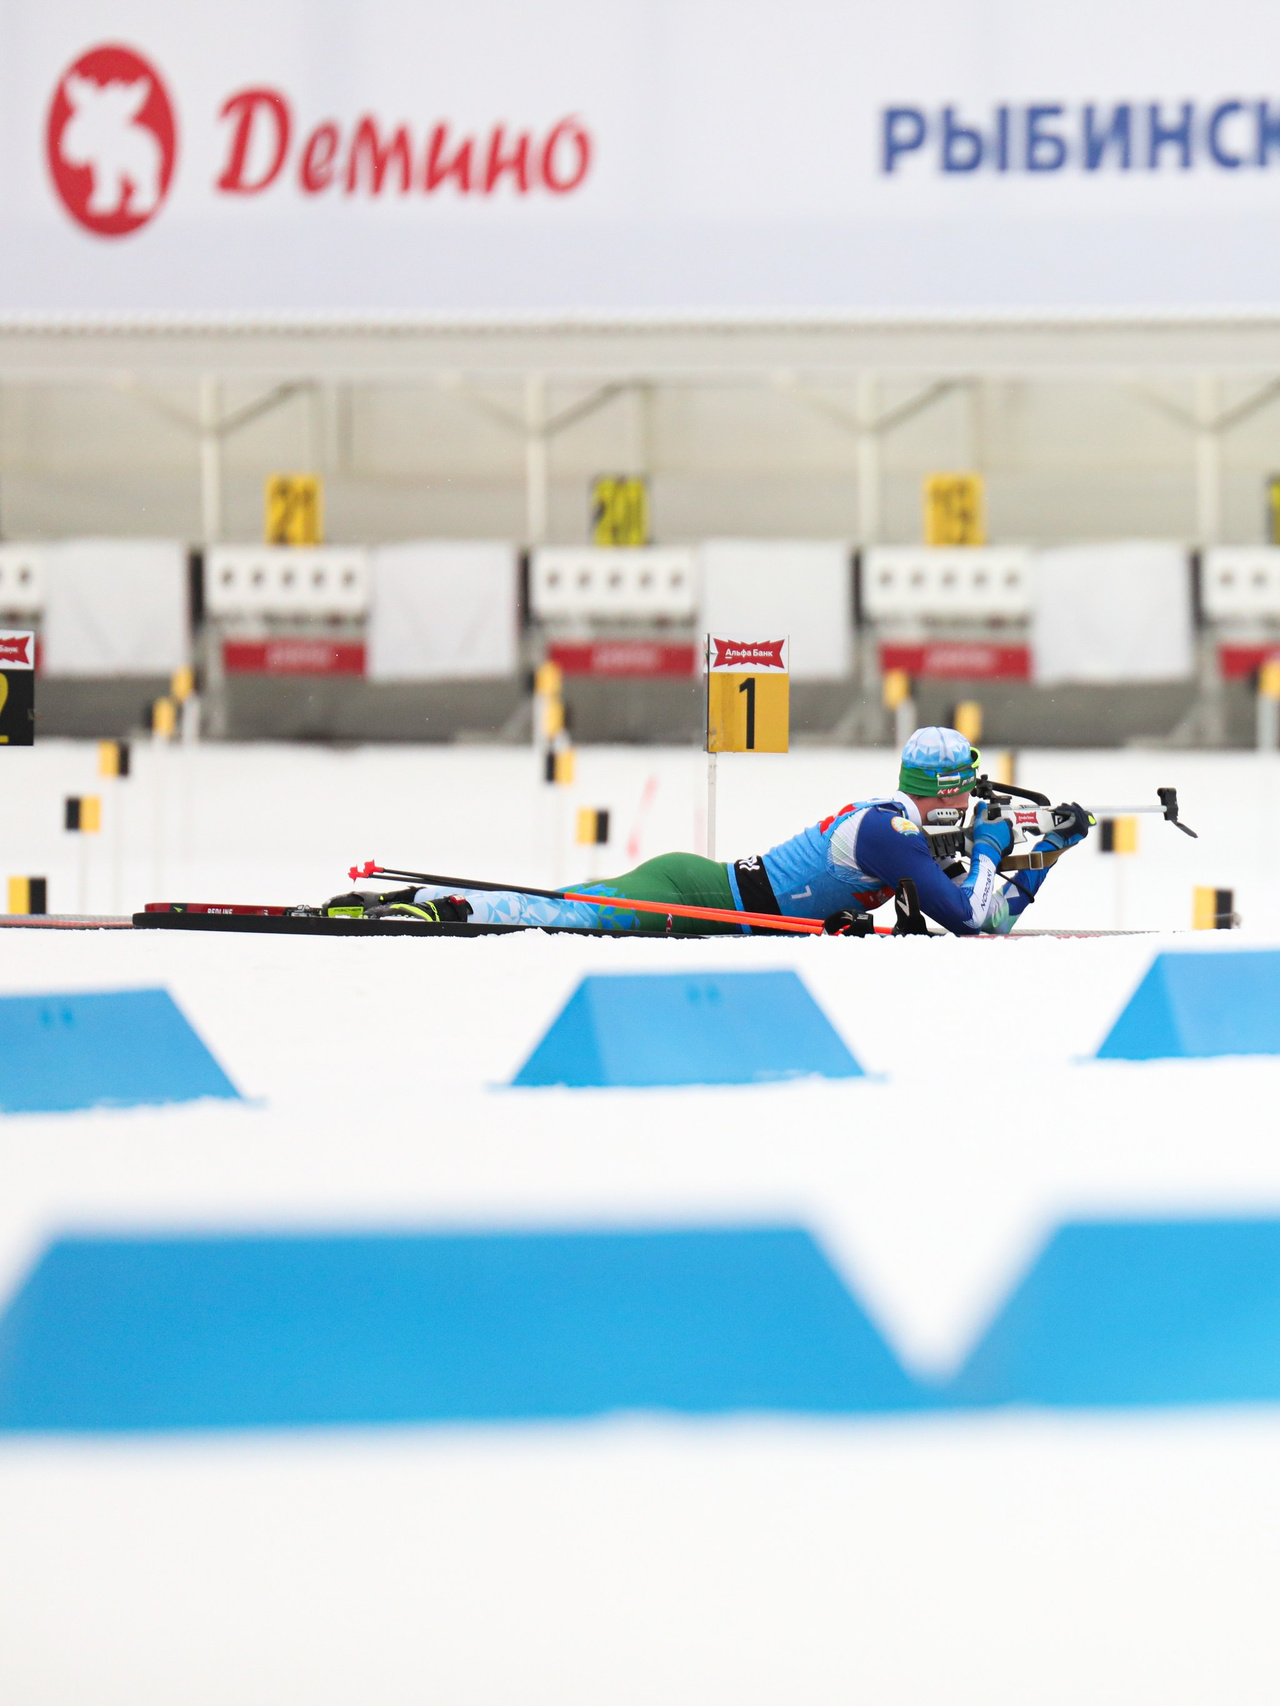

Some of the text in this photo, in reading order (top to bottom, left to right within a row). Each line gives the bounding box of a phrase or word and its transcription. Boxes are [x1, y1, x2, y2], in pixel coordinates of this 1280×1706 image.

[216, 86, 592, 197] Демино
[725, 648, 773, 659] Альфа Банк
[739, 677, 755, 750] 1
